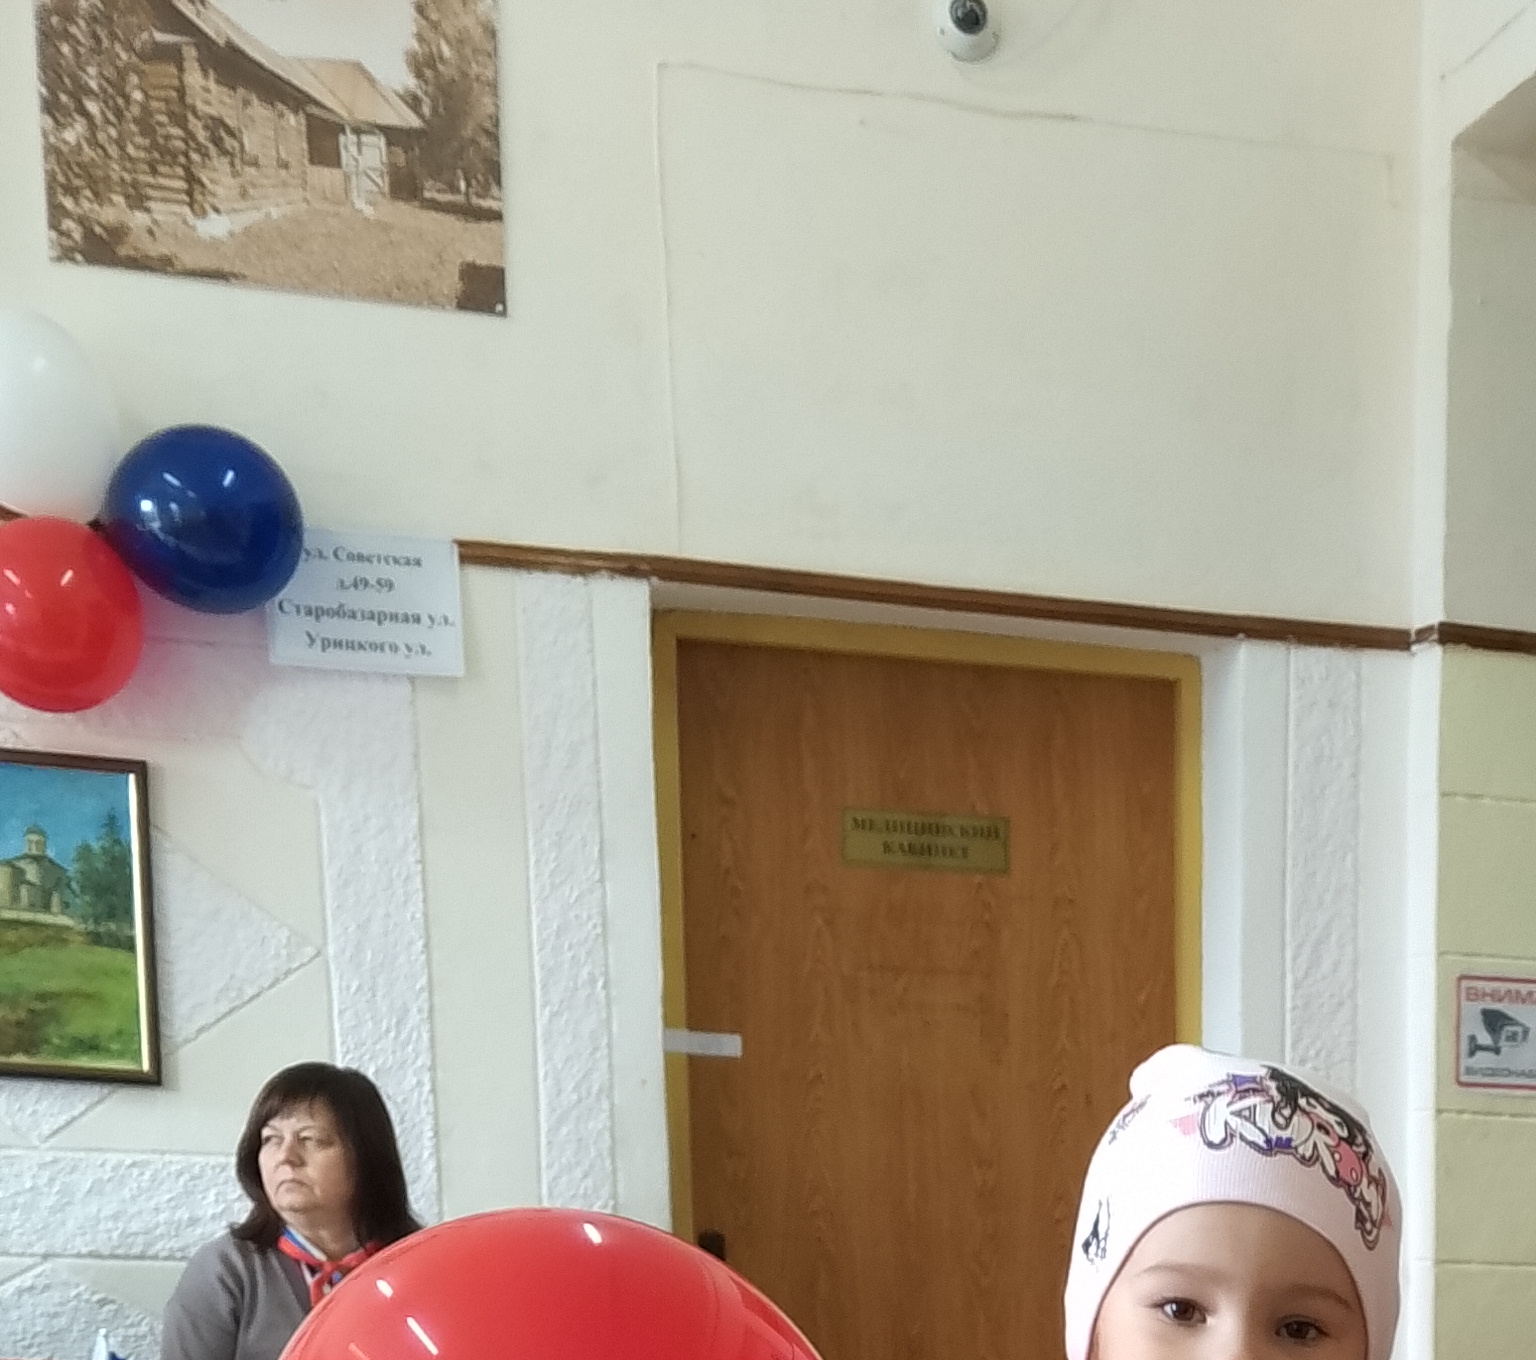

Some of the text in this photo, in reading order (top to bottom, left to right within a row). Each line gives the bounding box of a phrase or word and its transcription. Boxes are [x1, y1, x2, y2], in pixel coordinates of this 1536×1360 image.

[332, 546, 423, 567] Советская
[277, 599, 455, 629] Старобазарная ул.
[304, 630, 399, 653] Урицкого
